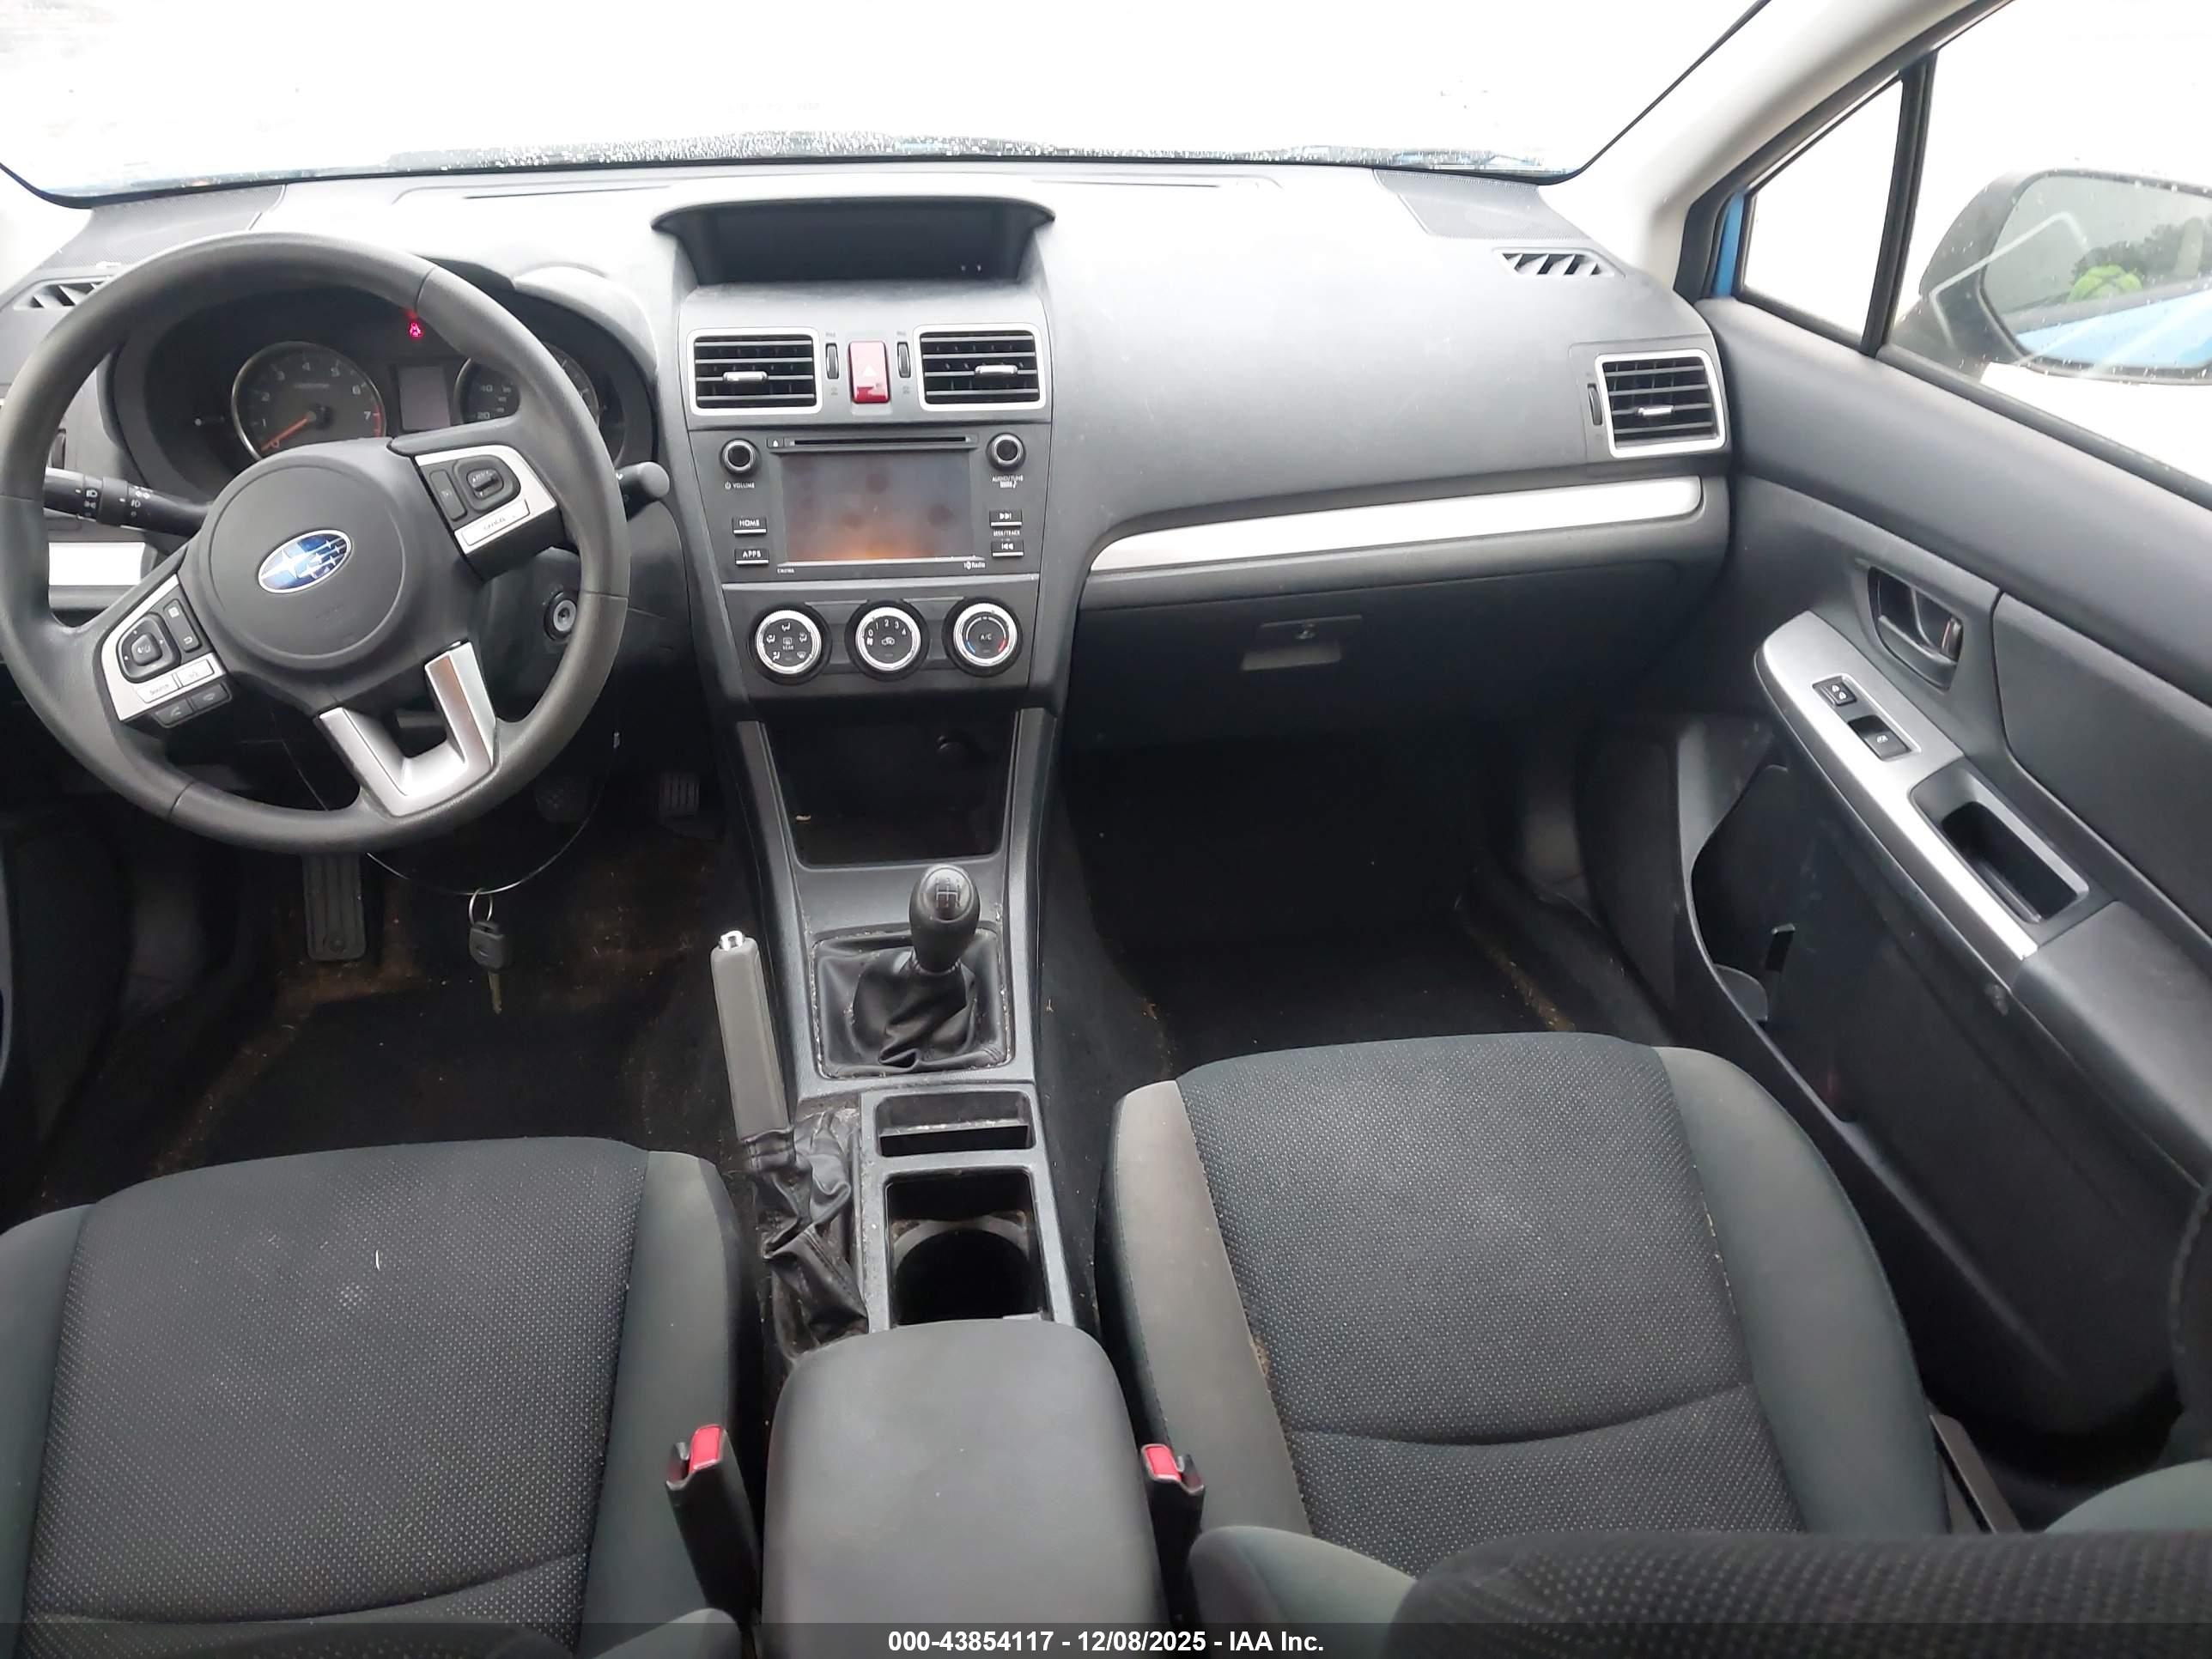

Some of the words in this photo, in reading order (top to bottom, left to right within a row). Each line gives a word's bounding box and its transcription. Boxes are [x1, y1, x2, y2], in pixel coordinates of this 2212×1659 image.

[261, 392, 270, 402] 2
[301, 362, 312, 372] 4
[352, 386, 362, 396] 6
[364, 410, 372, 421] 7
[867, 629, 874, 637] 0
[884, 618, 890, 628] 2
[894, 620, 900, 629] 3
